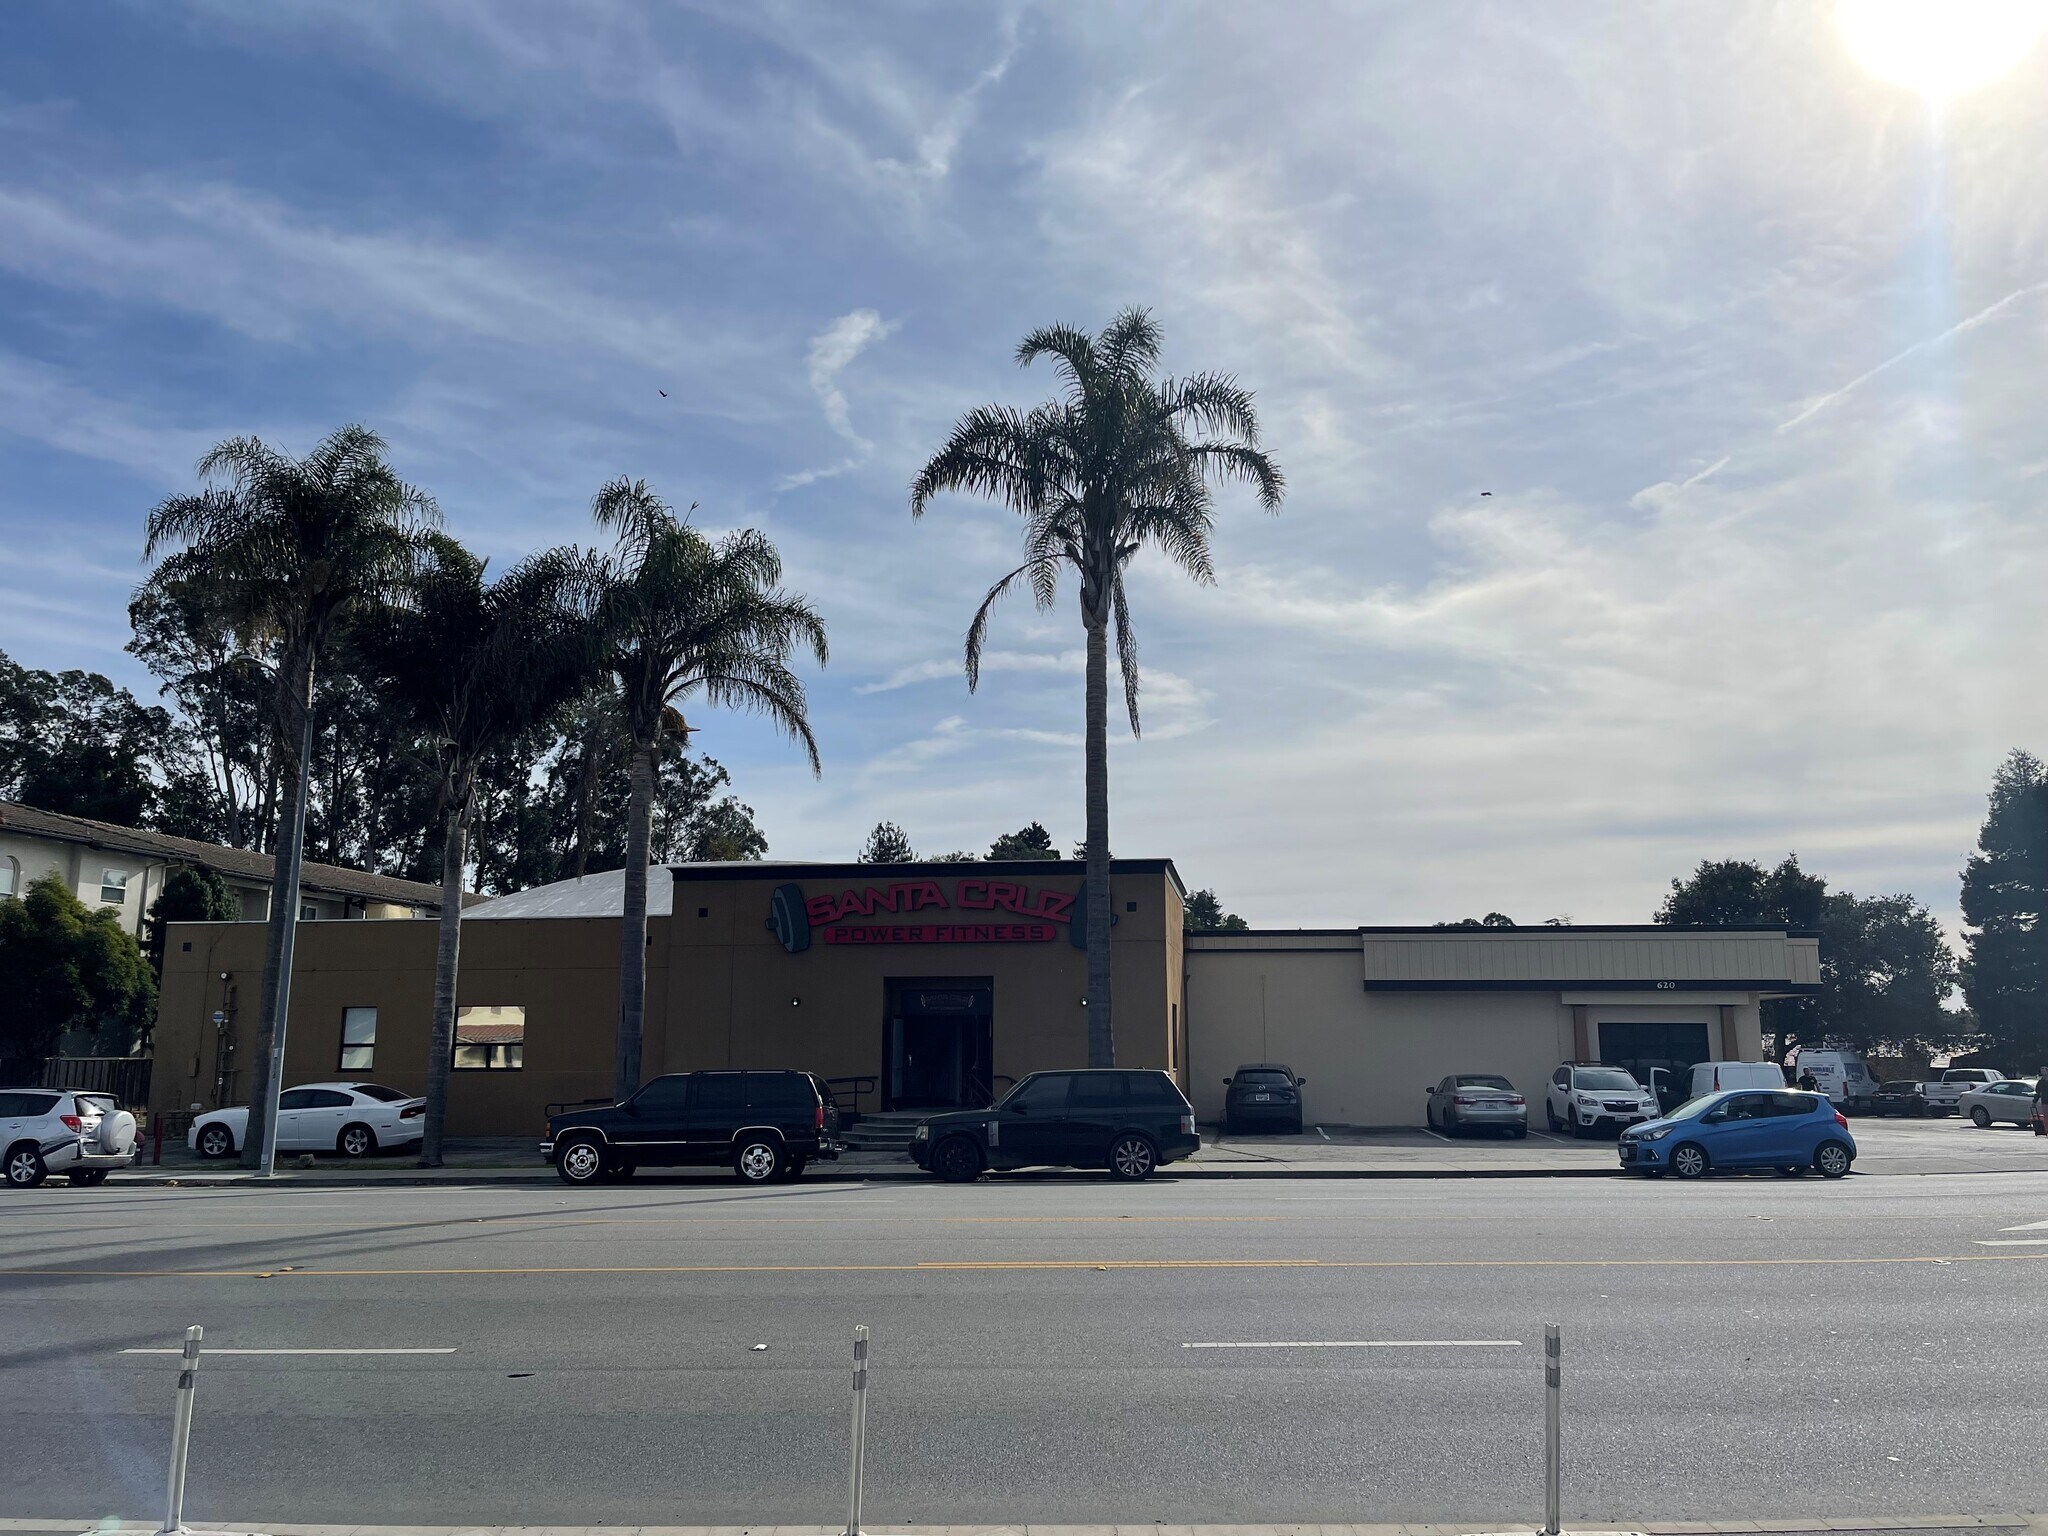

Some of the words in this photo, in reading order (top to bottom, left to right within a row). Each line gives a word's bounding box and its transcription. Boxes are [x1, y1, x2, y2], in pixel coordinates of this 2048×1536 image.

[806, 880, 949, 926] SANTA
[956, 879, 1076, 924] CRUZ
[834, 926, 922, 941] POWER
[936, 925, 1044, 941] FITNESS
[1656, 981, 1676, 989] 620
